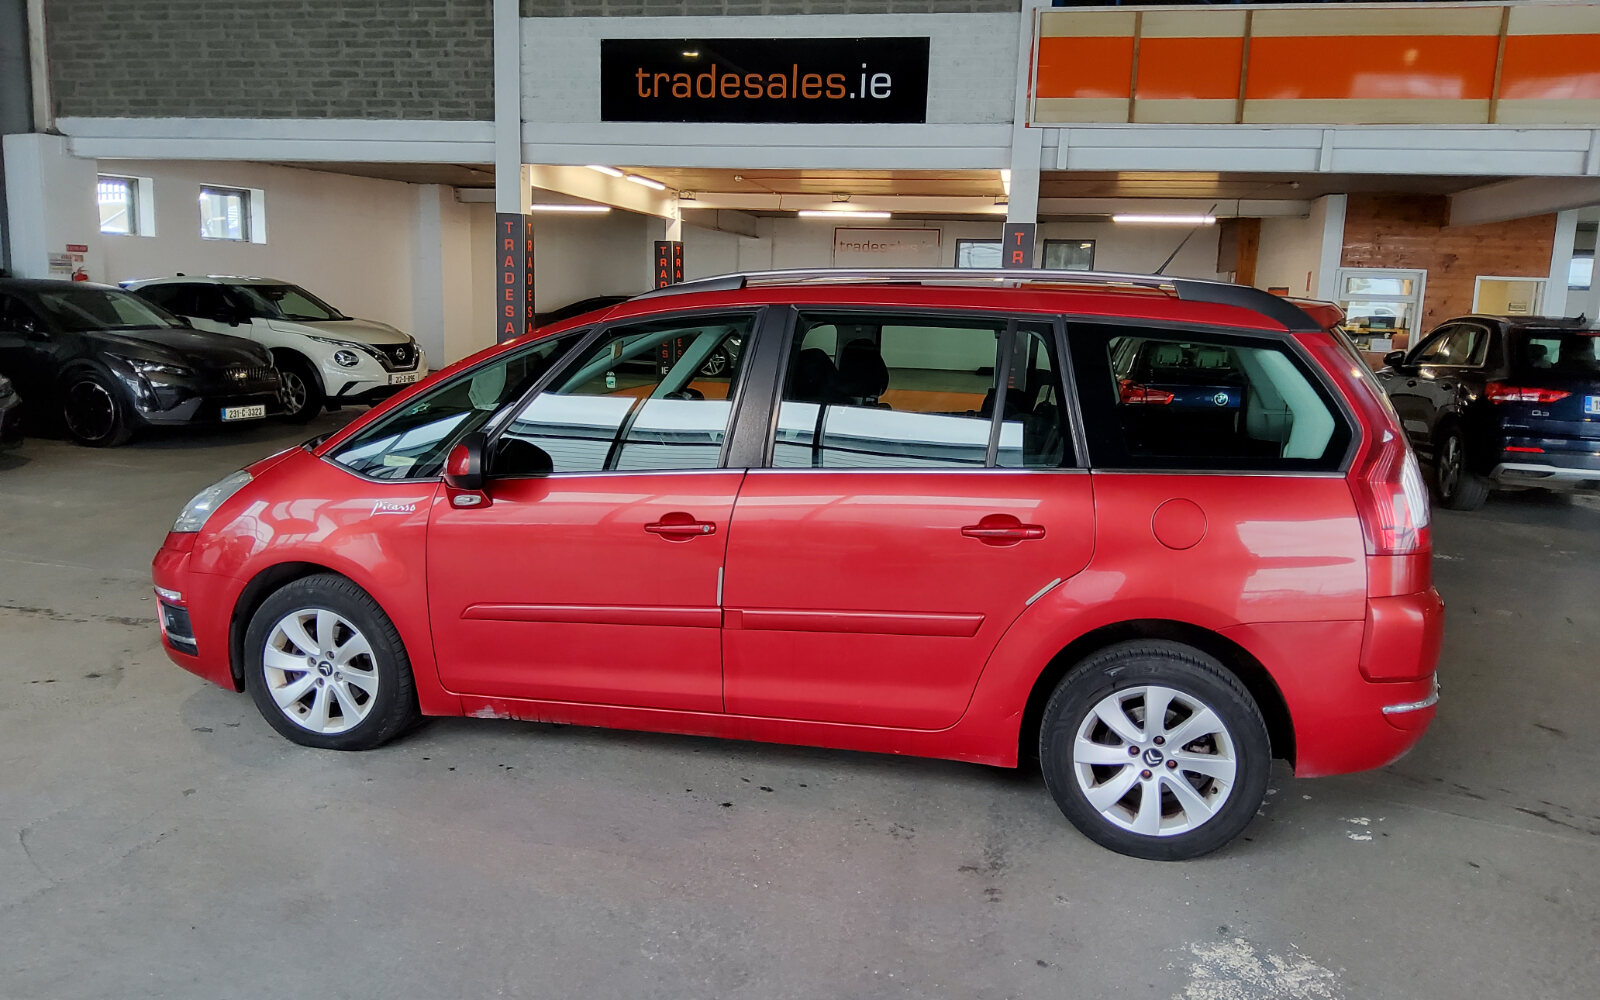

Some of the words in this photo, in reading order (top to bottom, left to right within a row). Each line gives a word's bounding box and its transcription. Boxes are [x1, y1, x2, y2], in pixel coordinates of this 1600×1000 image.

[636, 63, 892, 99] tradesales.ie
[229, 407, 262, 418] 231-C-3323
[369, 498, 416, 517] Picasso
